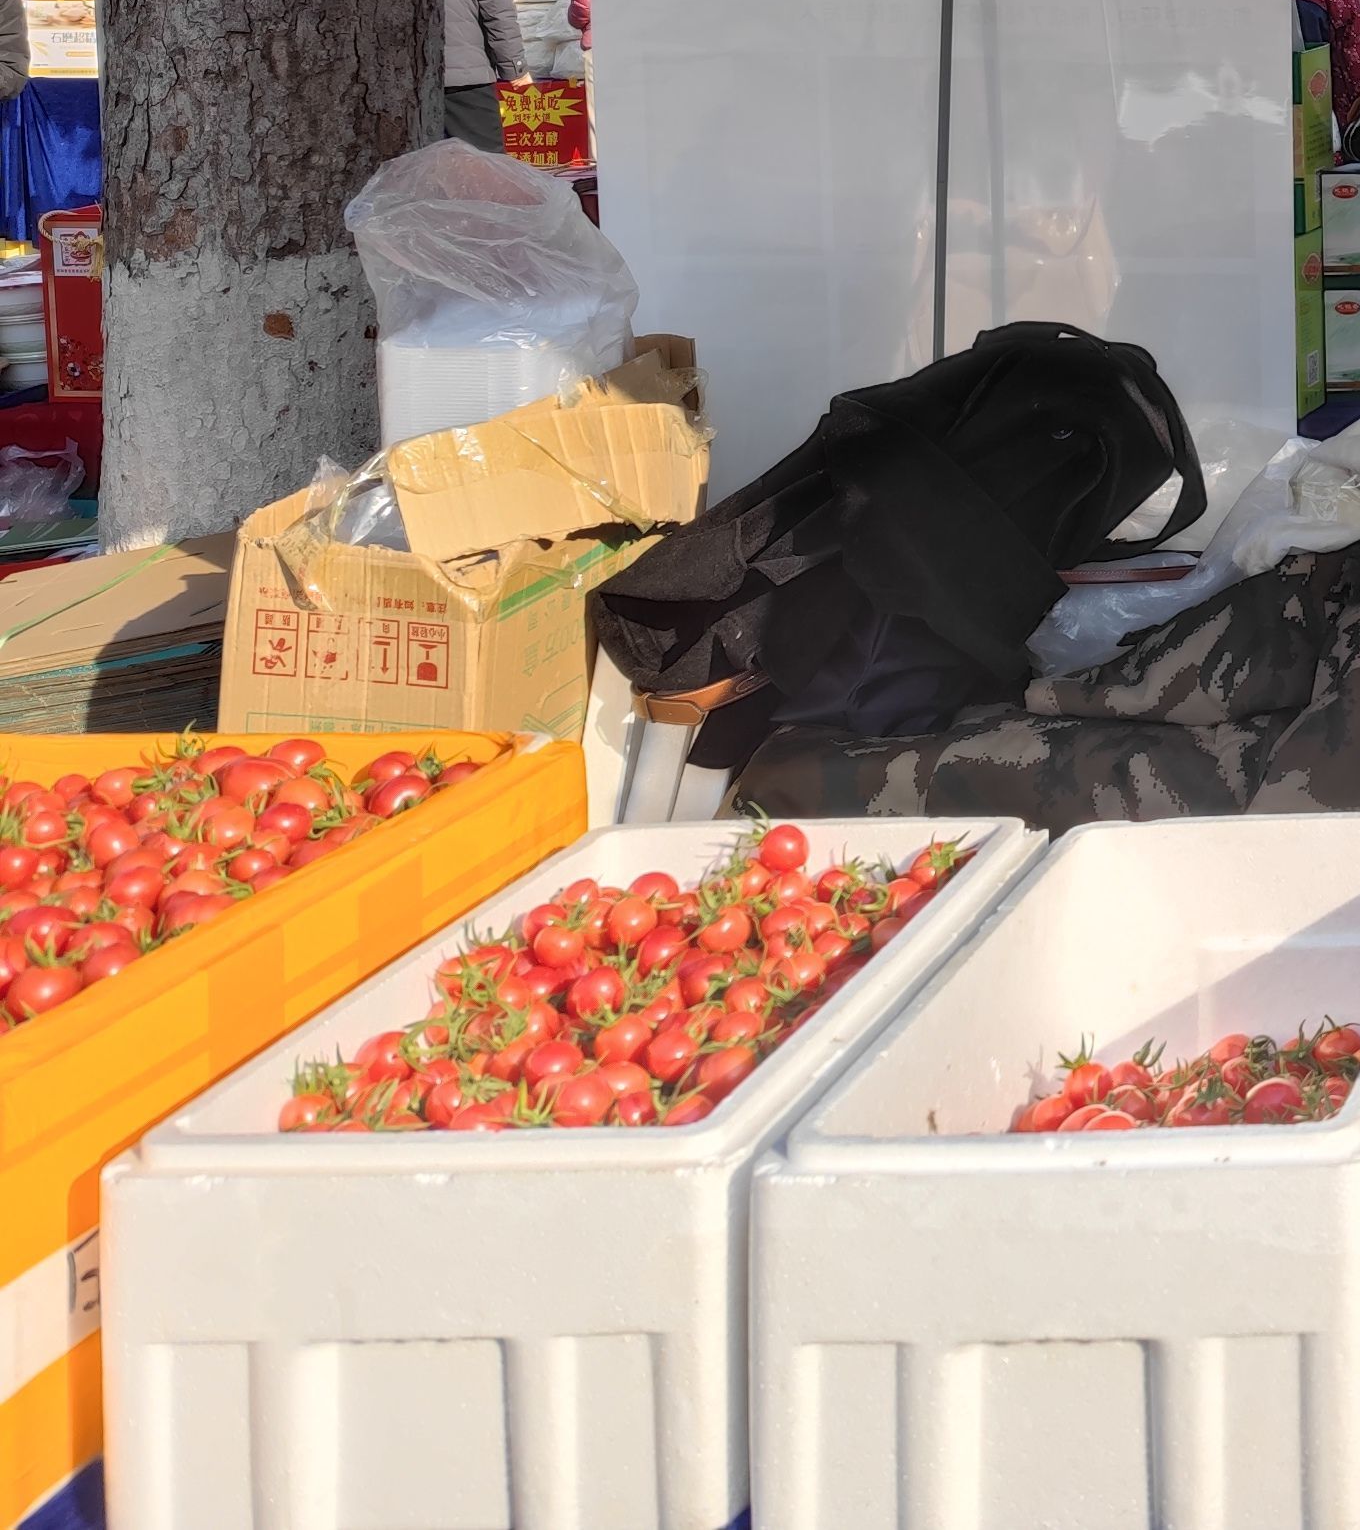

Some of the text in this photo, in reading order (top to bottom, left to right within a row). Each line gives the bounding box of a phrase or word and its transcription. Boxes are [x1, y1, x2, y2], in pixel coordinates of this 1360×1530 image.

[507, 95, 560, 111] 免费试吃
[506, 131, 559, 147] 三次发酵
[411, 625, 446, 641] 小心轻放
